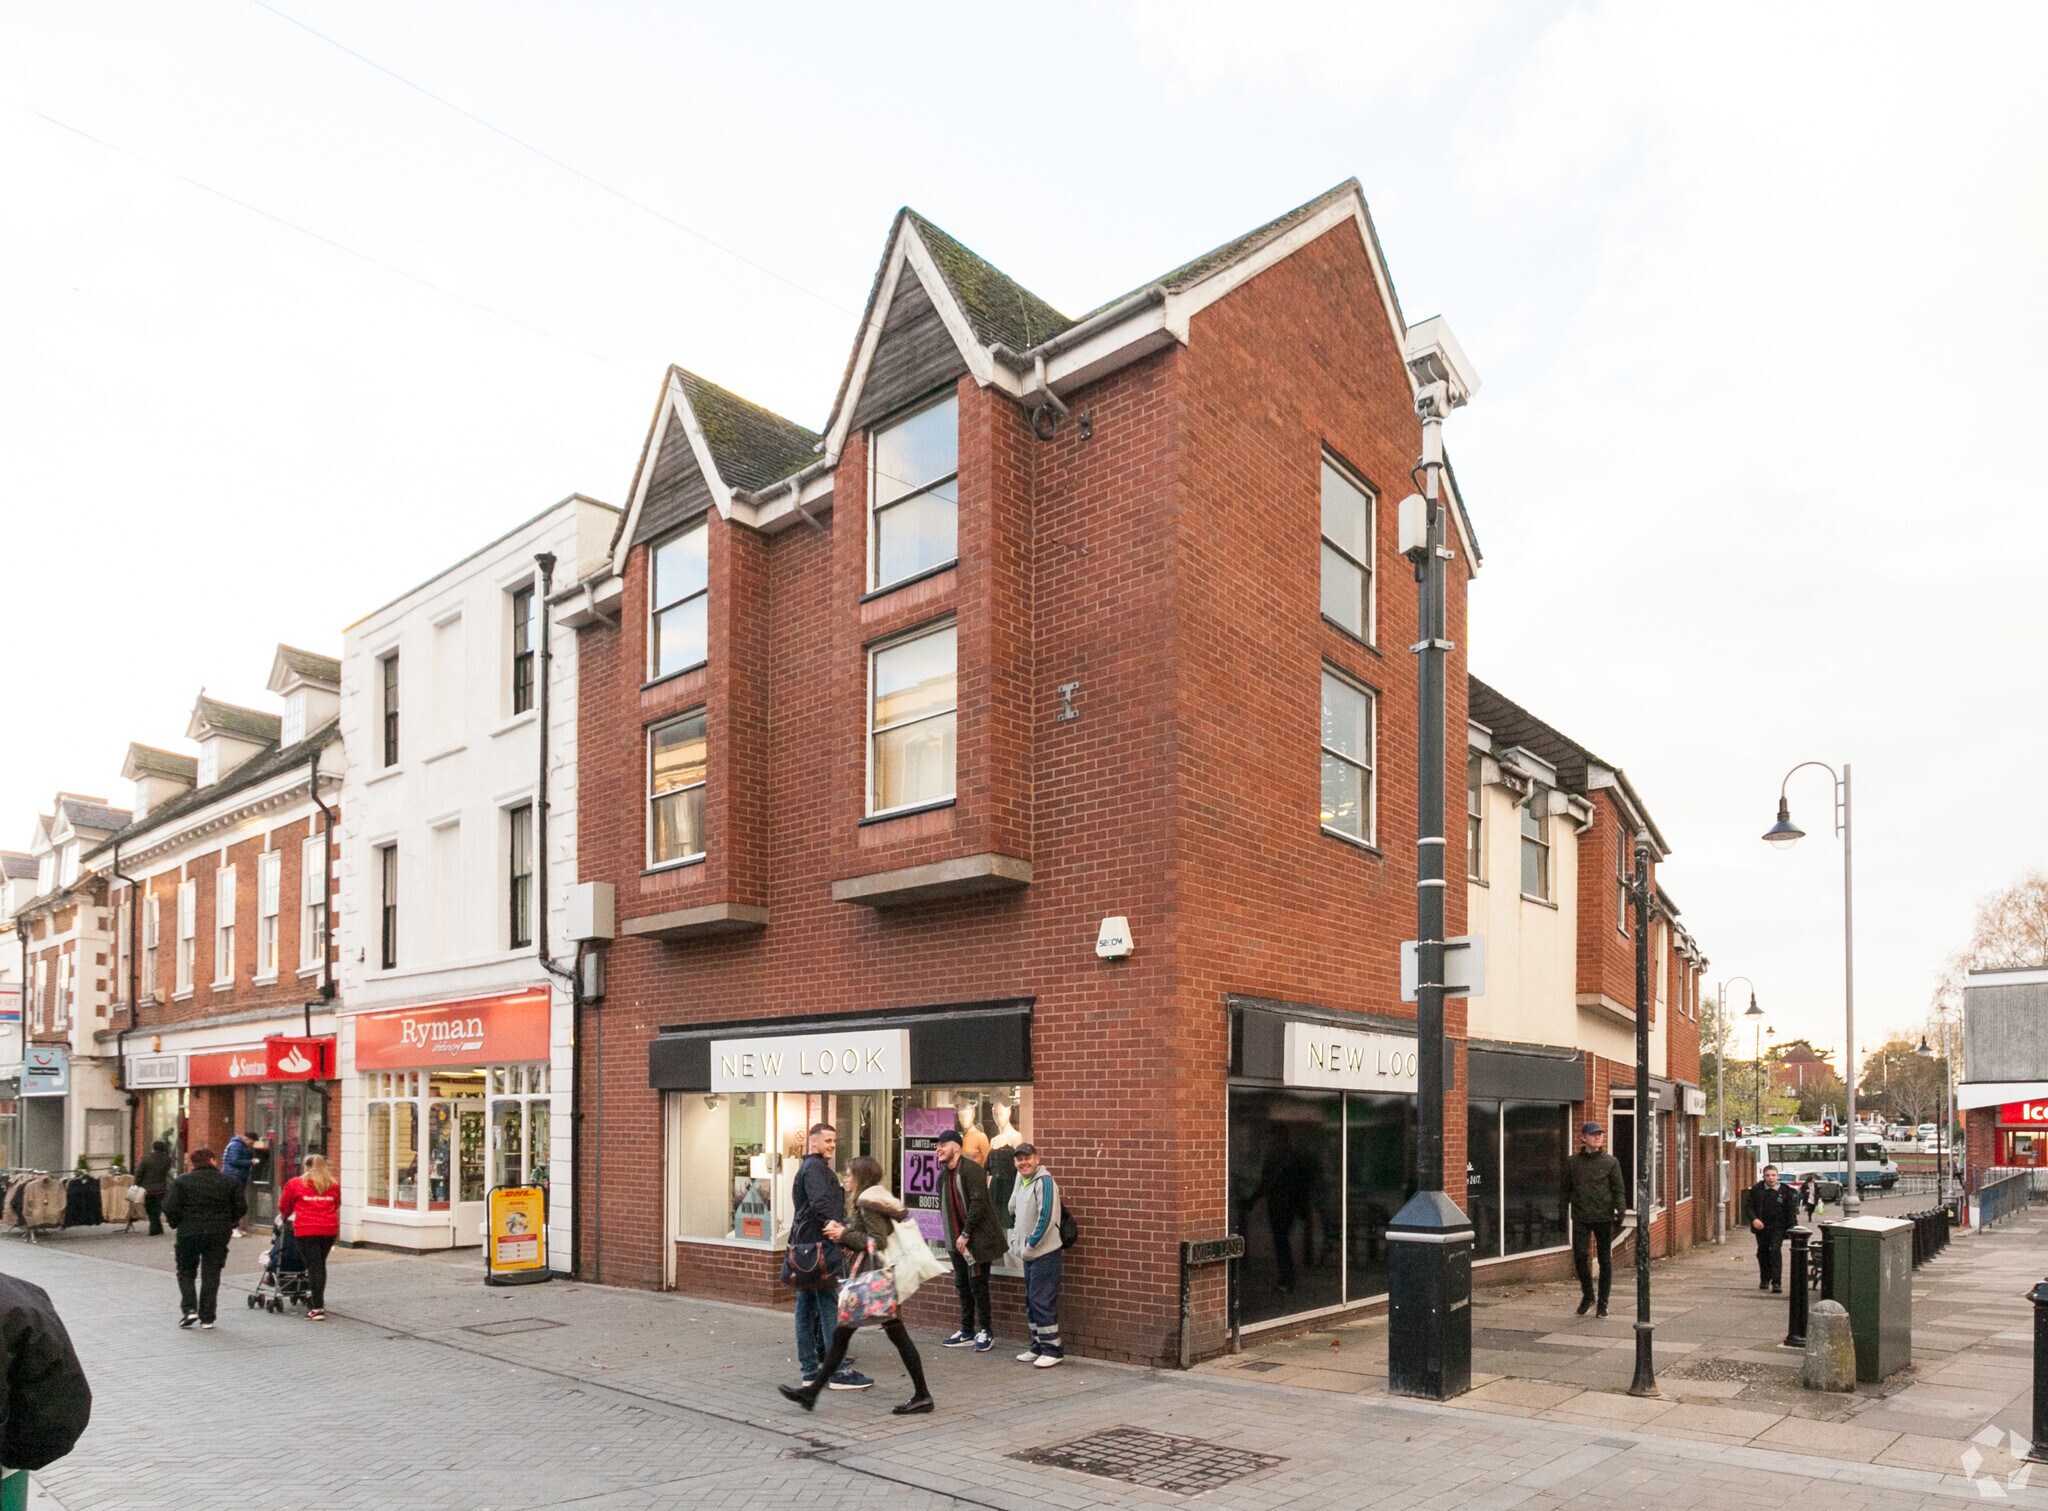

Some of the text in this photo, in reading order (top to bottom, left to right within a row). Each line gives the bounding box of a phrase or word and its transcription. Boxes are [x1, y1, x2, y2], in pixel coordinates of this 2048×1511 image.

[1099, 938, 1123, 947] SECOM
[400, 1017, 484, 1049] Ryman
[240, 1058, 267, 1077] Santan
[721, 1047, 886, 1078] NEW LOOK
[1307, 1041, 1418, 1077] NEW LOO
[912, 1139, 930, 1149] LIMITED
[919, 1195, 939, 1209] BOOTS
